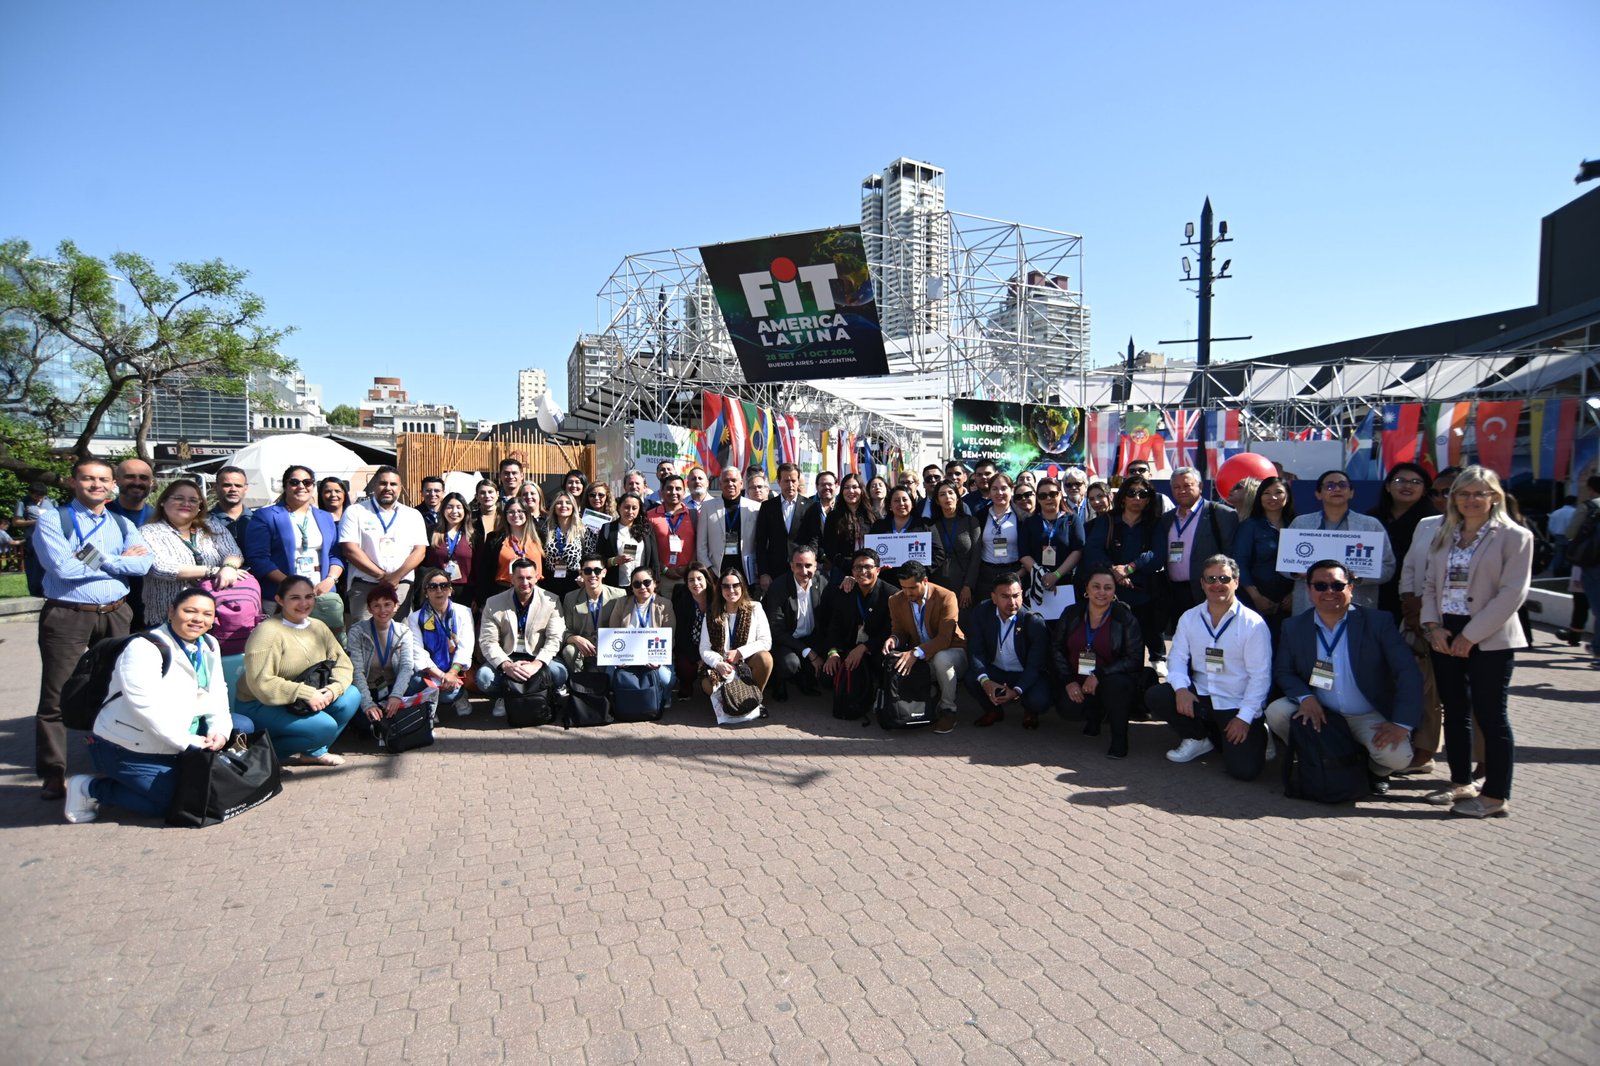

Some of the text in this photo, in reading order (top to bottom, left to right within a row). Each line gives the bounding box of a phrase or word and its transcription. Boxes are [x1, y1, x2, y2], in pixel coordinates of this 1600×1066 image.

[757, 313, 848, 333] AMERICA
[761, 328, 851, 347] LATINA
[766, 353, 777, 361] 28
[778, 352, 795, 360] SET
[809, 350, 830, 358] OCT
[831, 348, 854, 356] 2024
